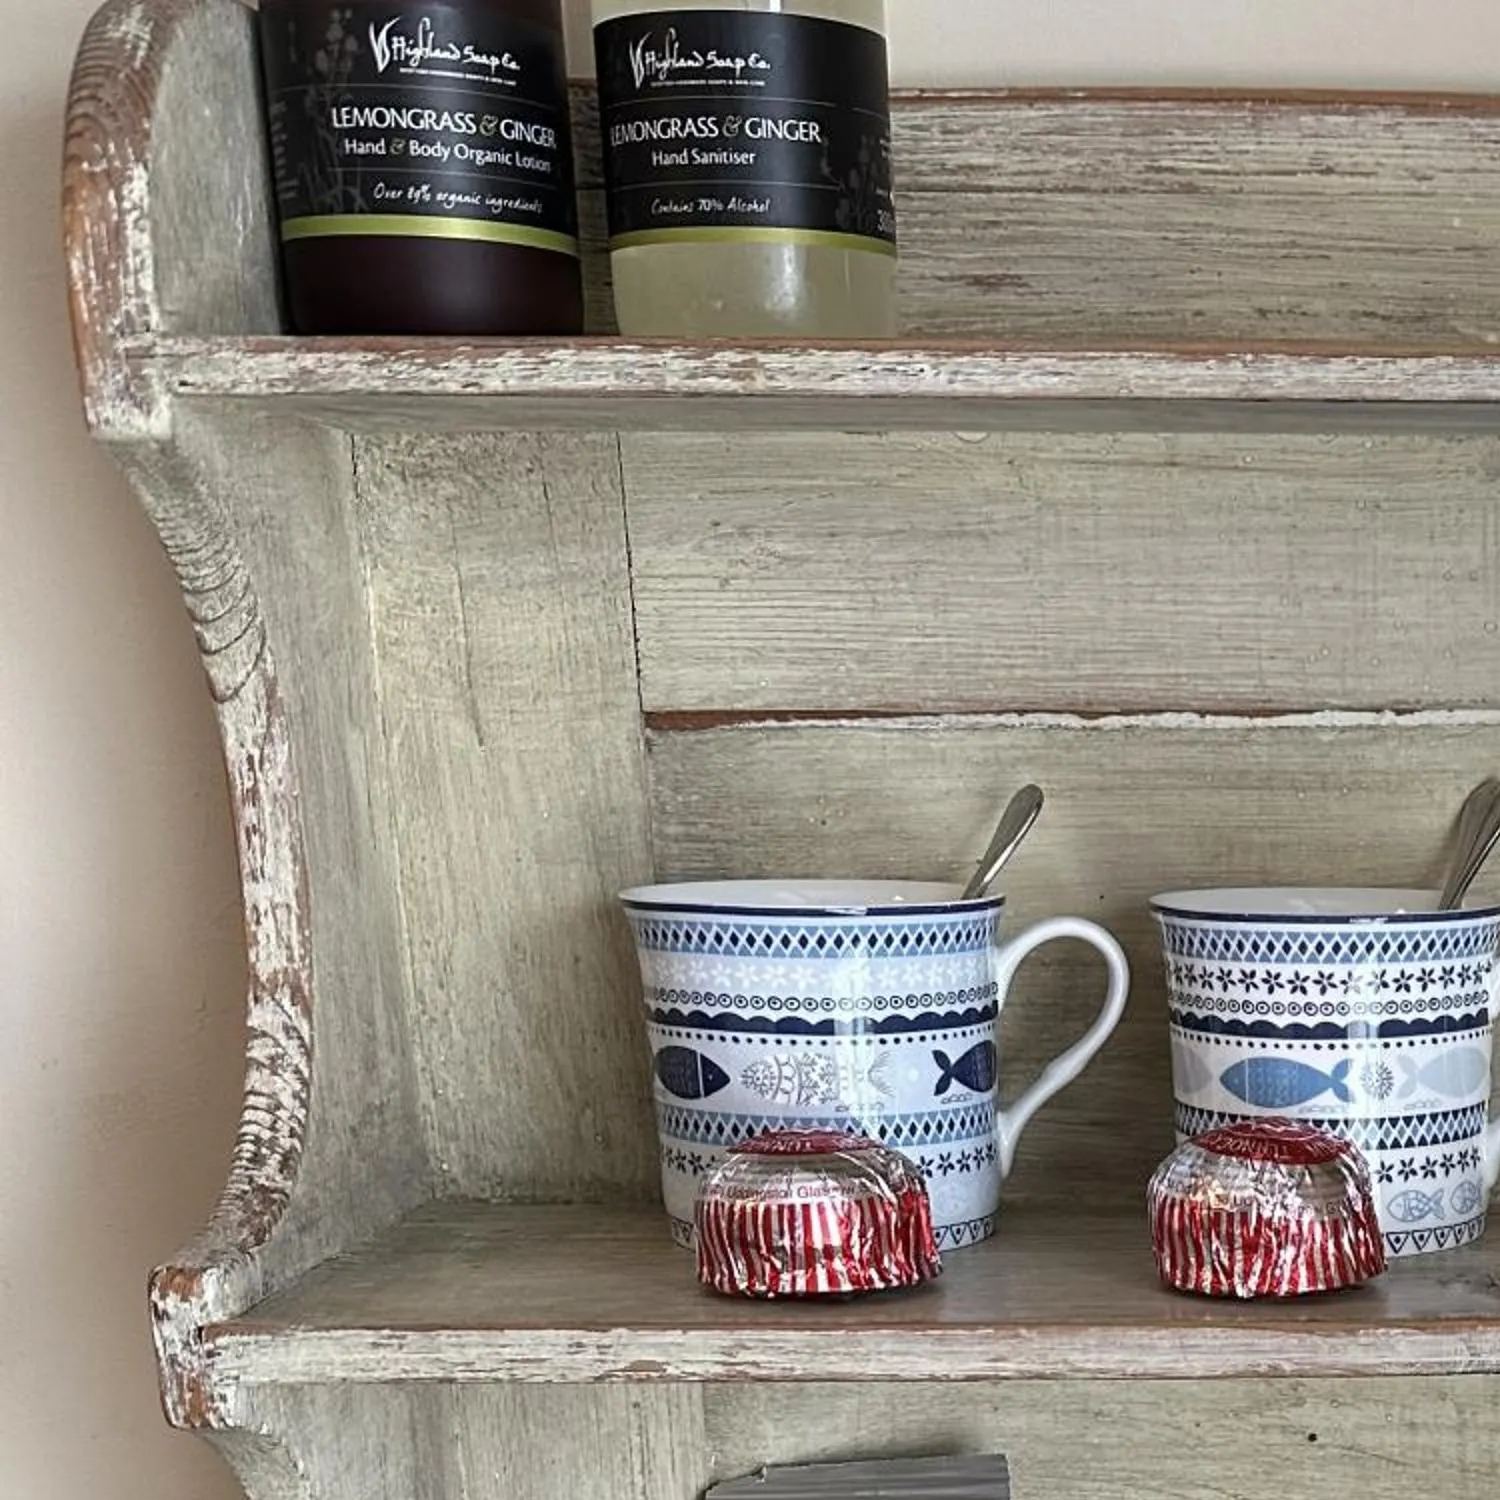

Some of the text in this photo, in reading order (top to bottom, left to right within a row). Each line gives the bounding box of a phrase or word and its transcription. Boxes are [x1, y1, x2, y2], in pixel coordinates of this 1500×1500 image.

[332, 106, 557, 148] LEMONGRASS & GINGER
[611, 115, 822, 147] LEMONGRASS & GINGER
[344, 138, 386, 155] Hand
[409, 140, 450, 162] Body
[453, 143, 512, 166] Organic
[515, 152, 551, 172] Lotion
[652, 148, 757, 166] Hand Sanitiser
[373, 182, 403, 200] Over
[436, 190, 482, 210] organic
[727, 197, 770, 214] Alcohol
